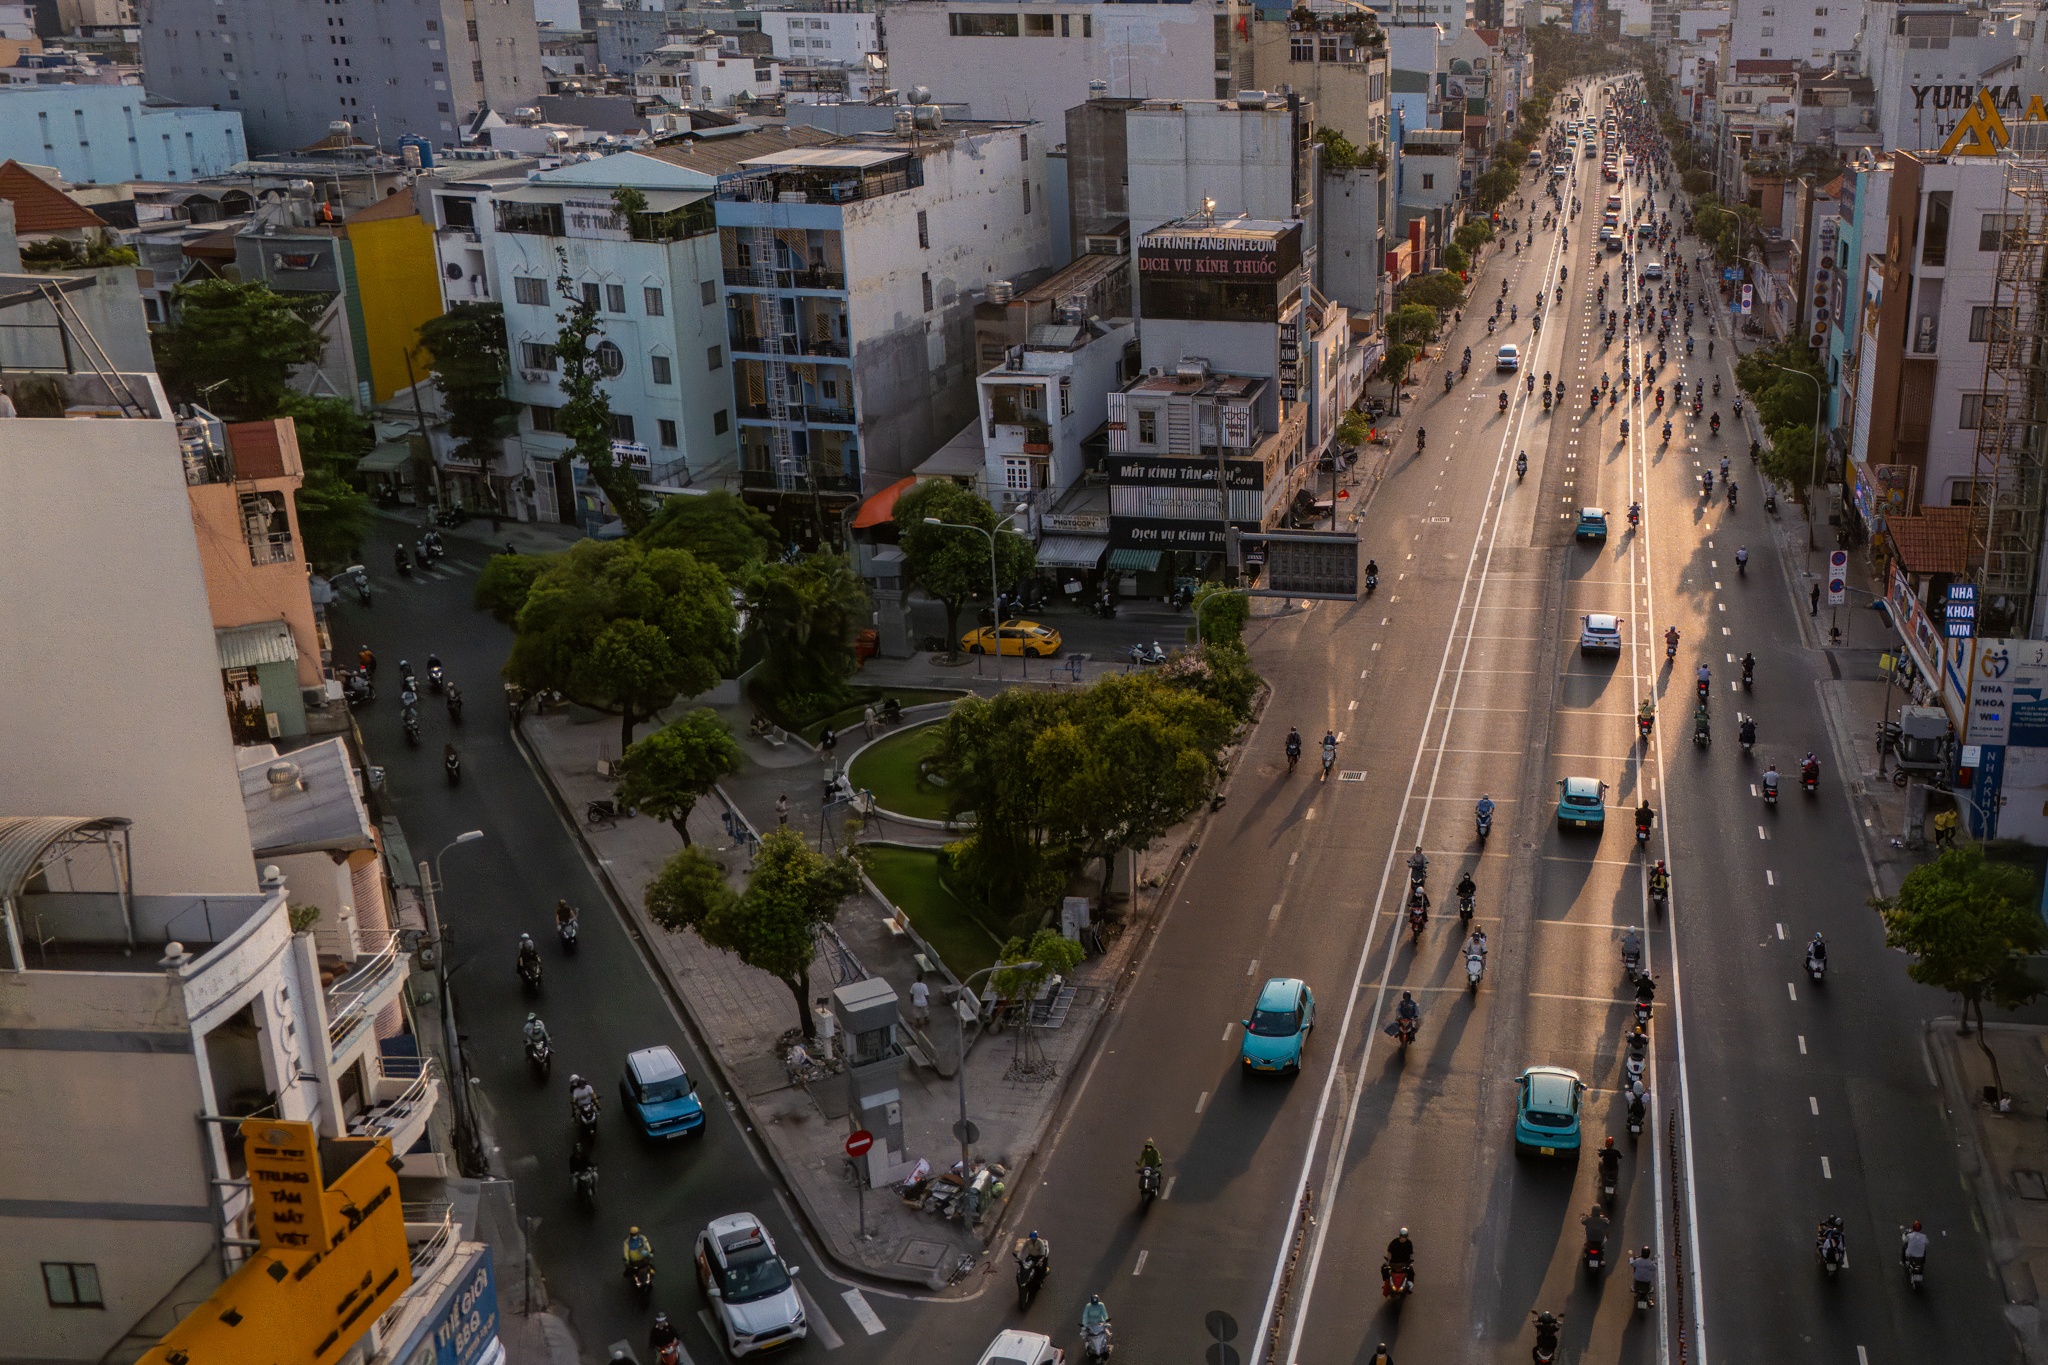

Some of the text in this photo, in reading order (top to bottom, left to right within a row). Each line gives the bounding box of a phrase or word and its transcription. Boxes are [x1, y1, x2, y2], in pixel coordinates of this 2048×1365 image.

[1138, 236, 1277, 252] MATKINHTANBINH.COM
[1140, 254, 1277, 274] DỊCH VỤ KÍNH THUỐC
[1148, 465, 1177, 479] KÍNH
[1180, 465, 1203, 480] TÂN
[1053, 519, 1096, 527] PHOTOCOPY
[1951, 587, 1973, 599] NHA
[1946, 605, 1975, 618] KHOA
[1949, 624, 1970, 636] WIN
[1980, 685, 2003, 693] NHA
[1974, 698, 2005, 708] KHOA
[1980, 713, 2000, 721] WIN
